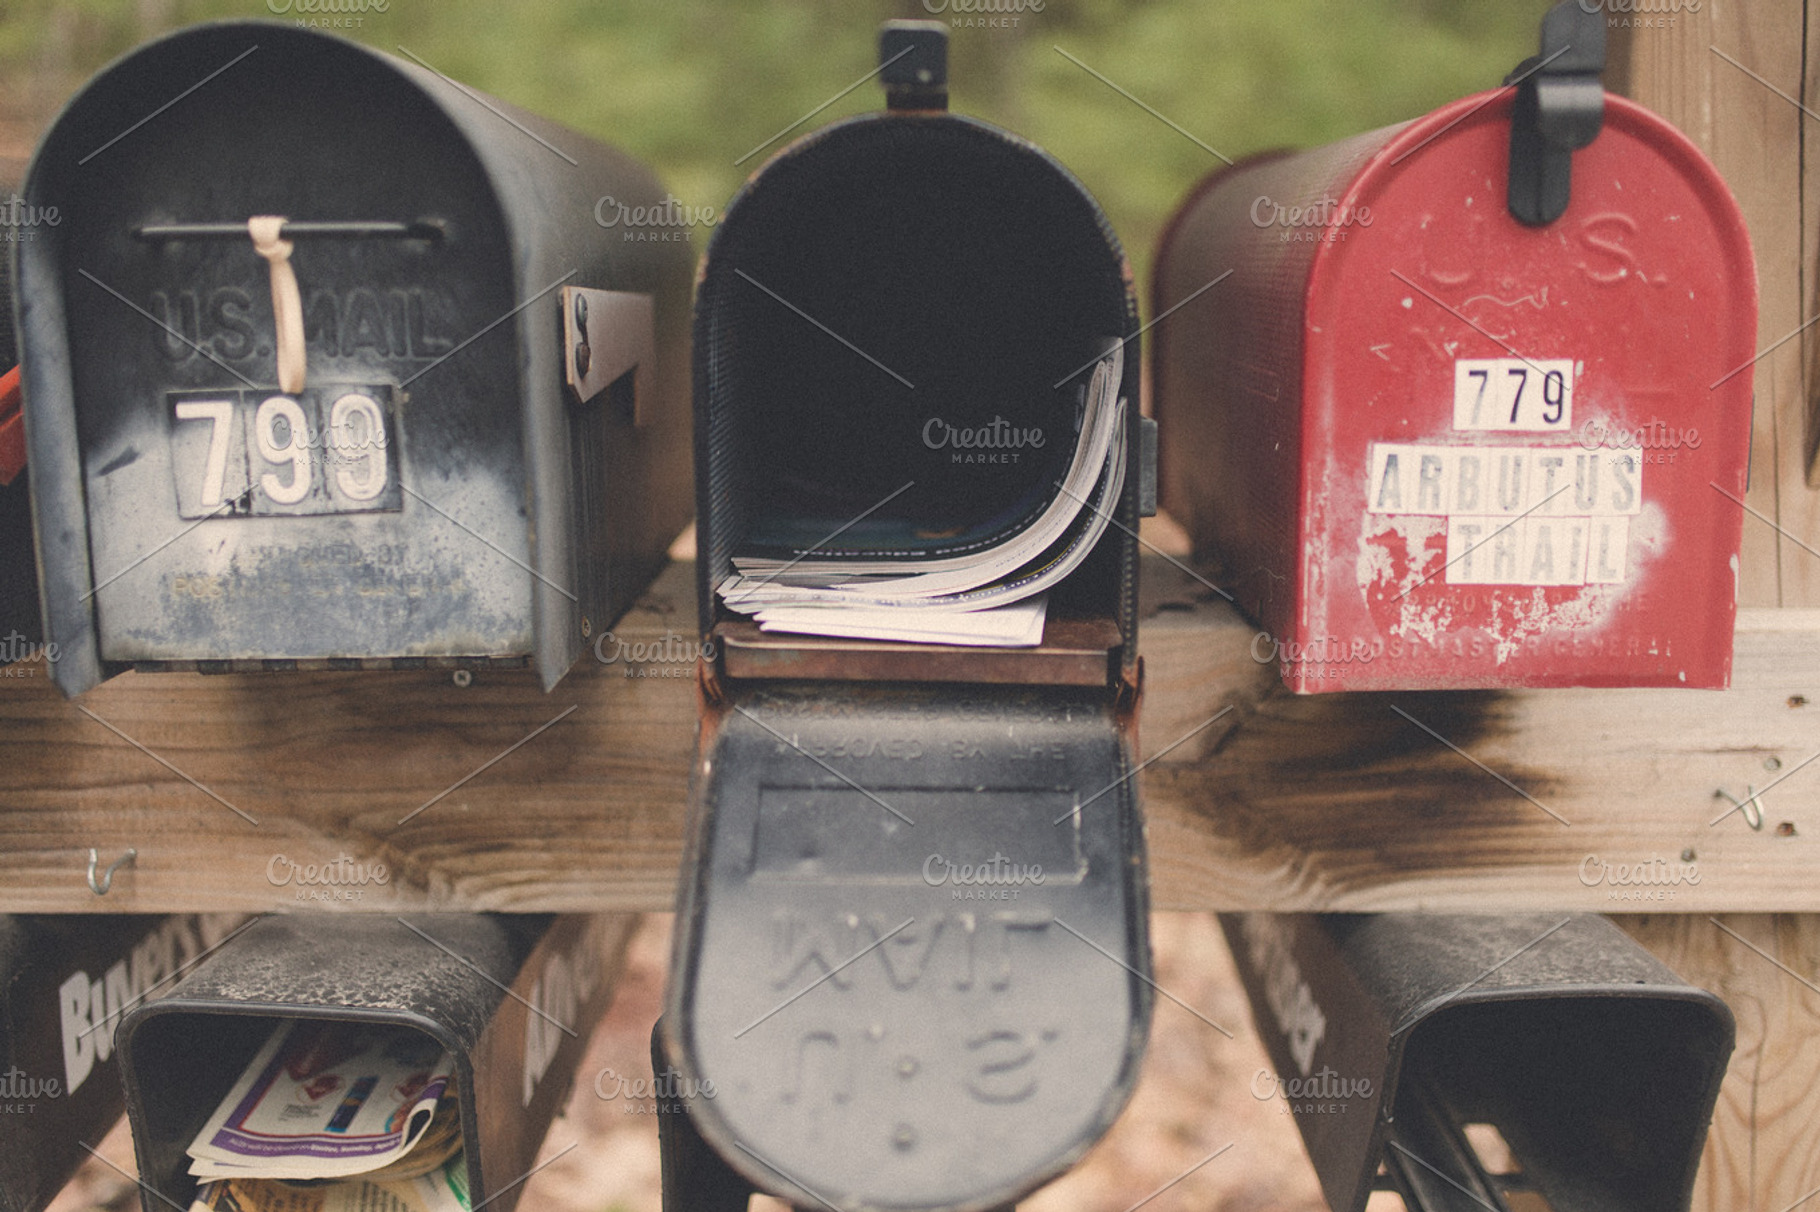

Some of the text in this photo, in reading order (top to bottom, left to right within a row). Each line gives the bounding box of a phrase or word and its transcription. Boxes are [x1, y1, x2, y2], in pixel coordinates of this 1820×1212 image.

[1468, 368, 1566, 425] 779
[175, 393, 389, 506] 799
[1376, 453, 1636, 512] ARBUTUS
[1457, 523, 1618, 581] TRAIL
